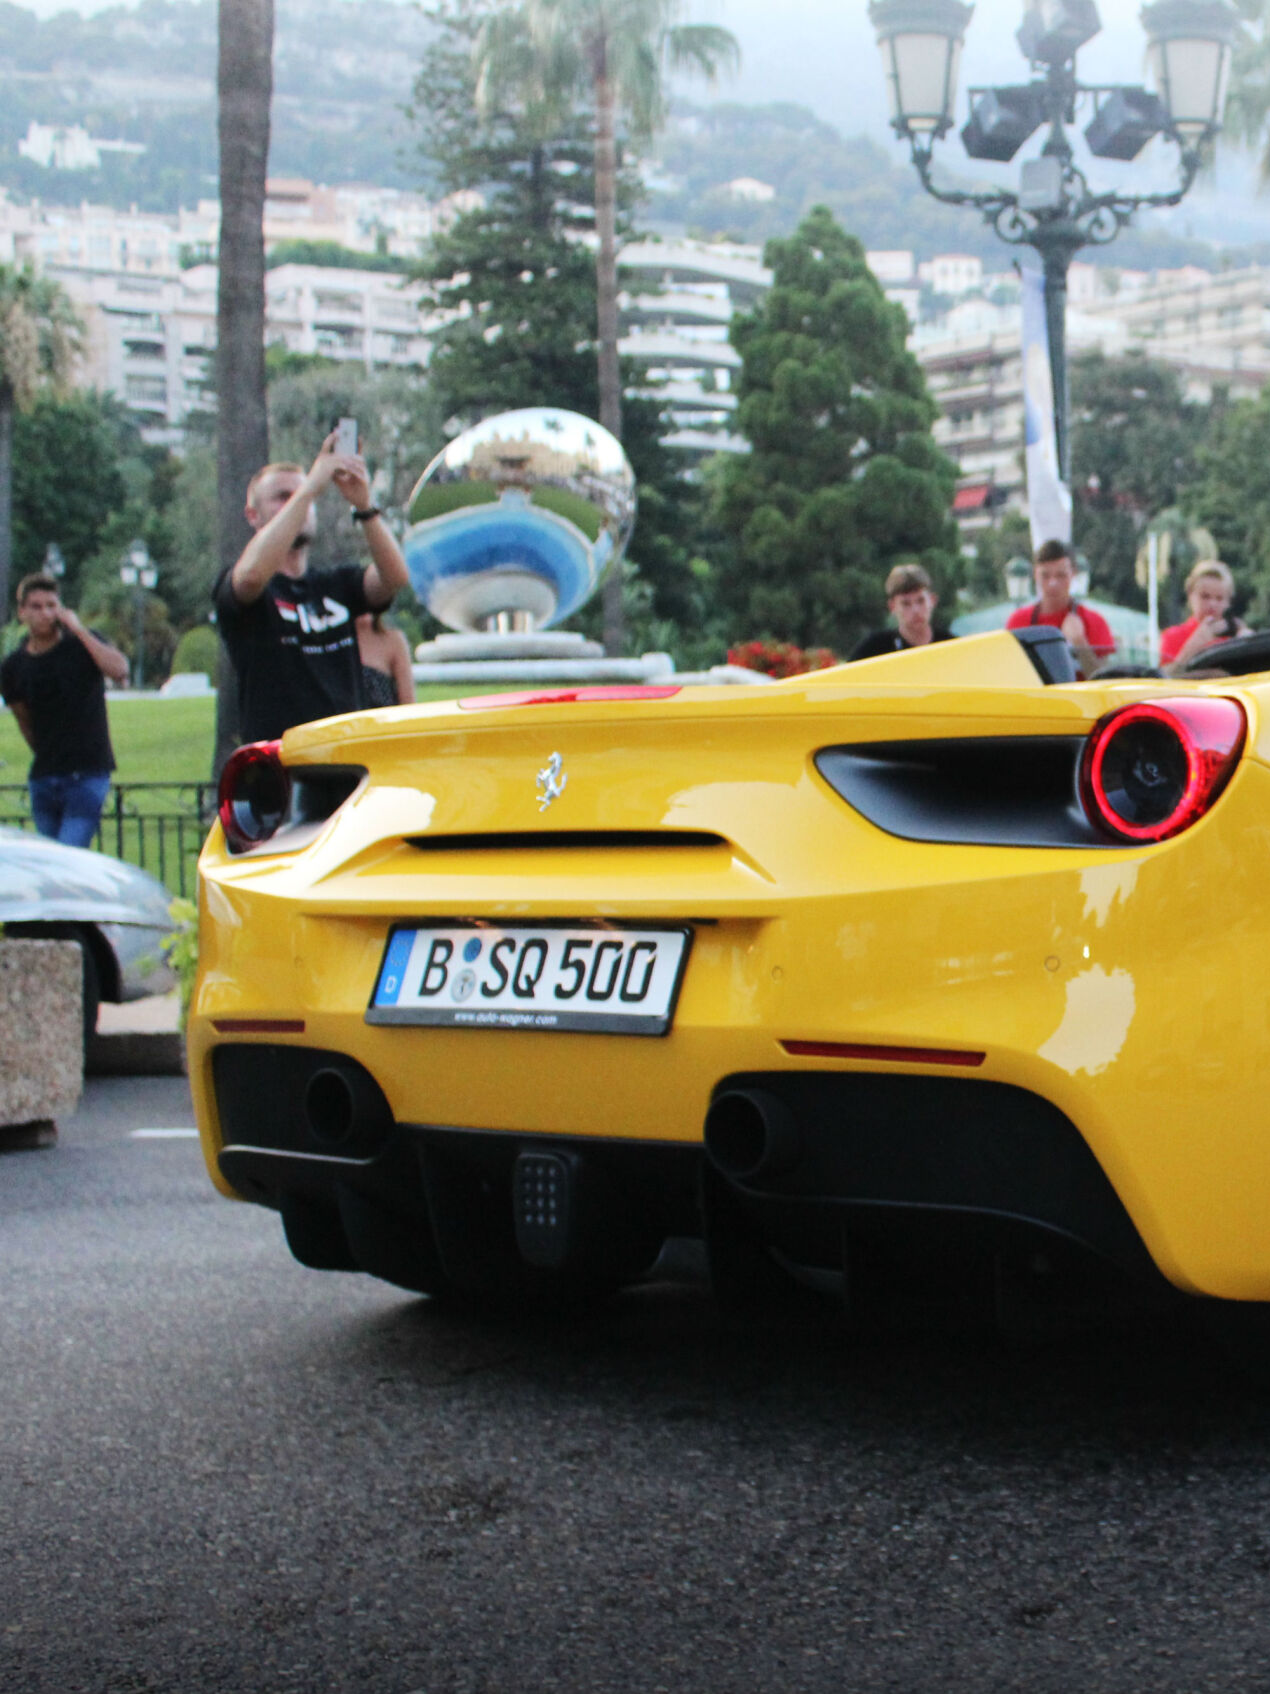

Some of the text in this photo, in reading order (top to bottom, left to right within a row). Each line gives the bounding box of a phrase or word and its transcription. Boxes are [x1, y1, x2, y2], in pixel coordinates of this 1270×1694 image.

[418, 937, 658, 1002] B SQ 500
[384, 975, 397, 993] D
[454, 1012, 558, 1026] www.auto-wagner.com
